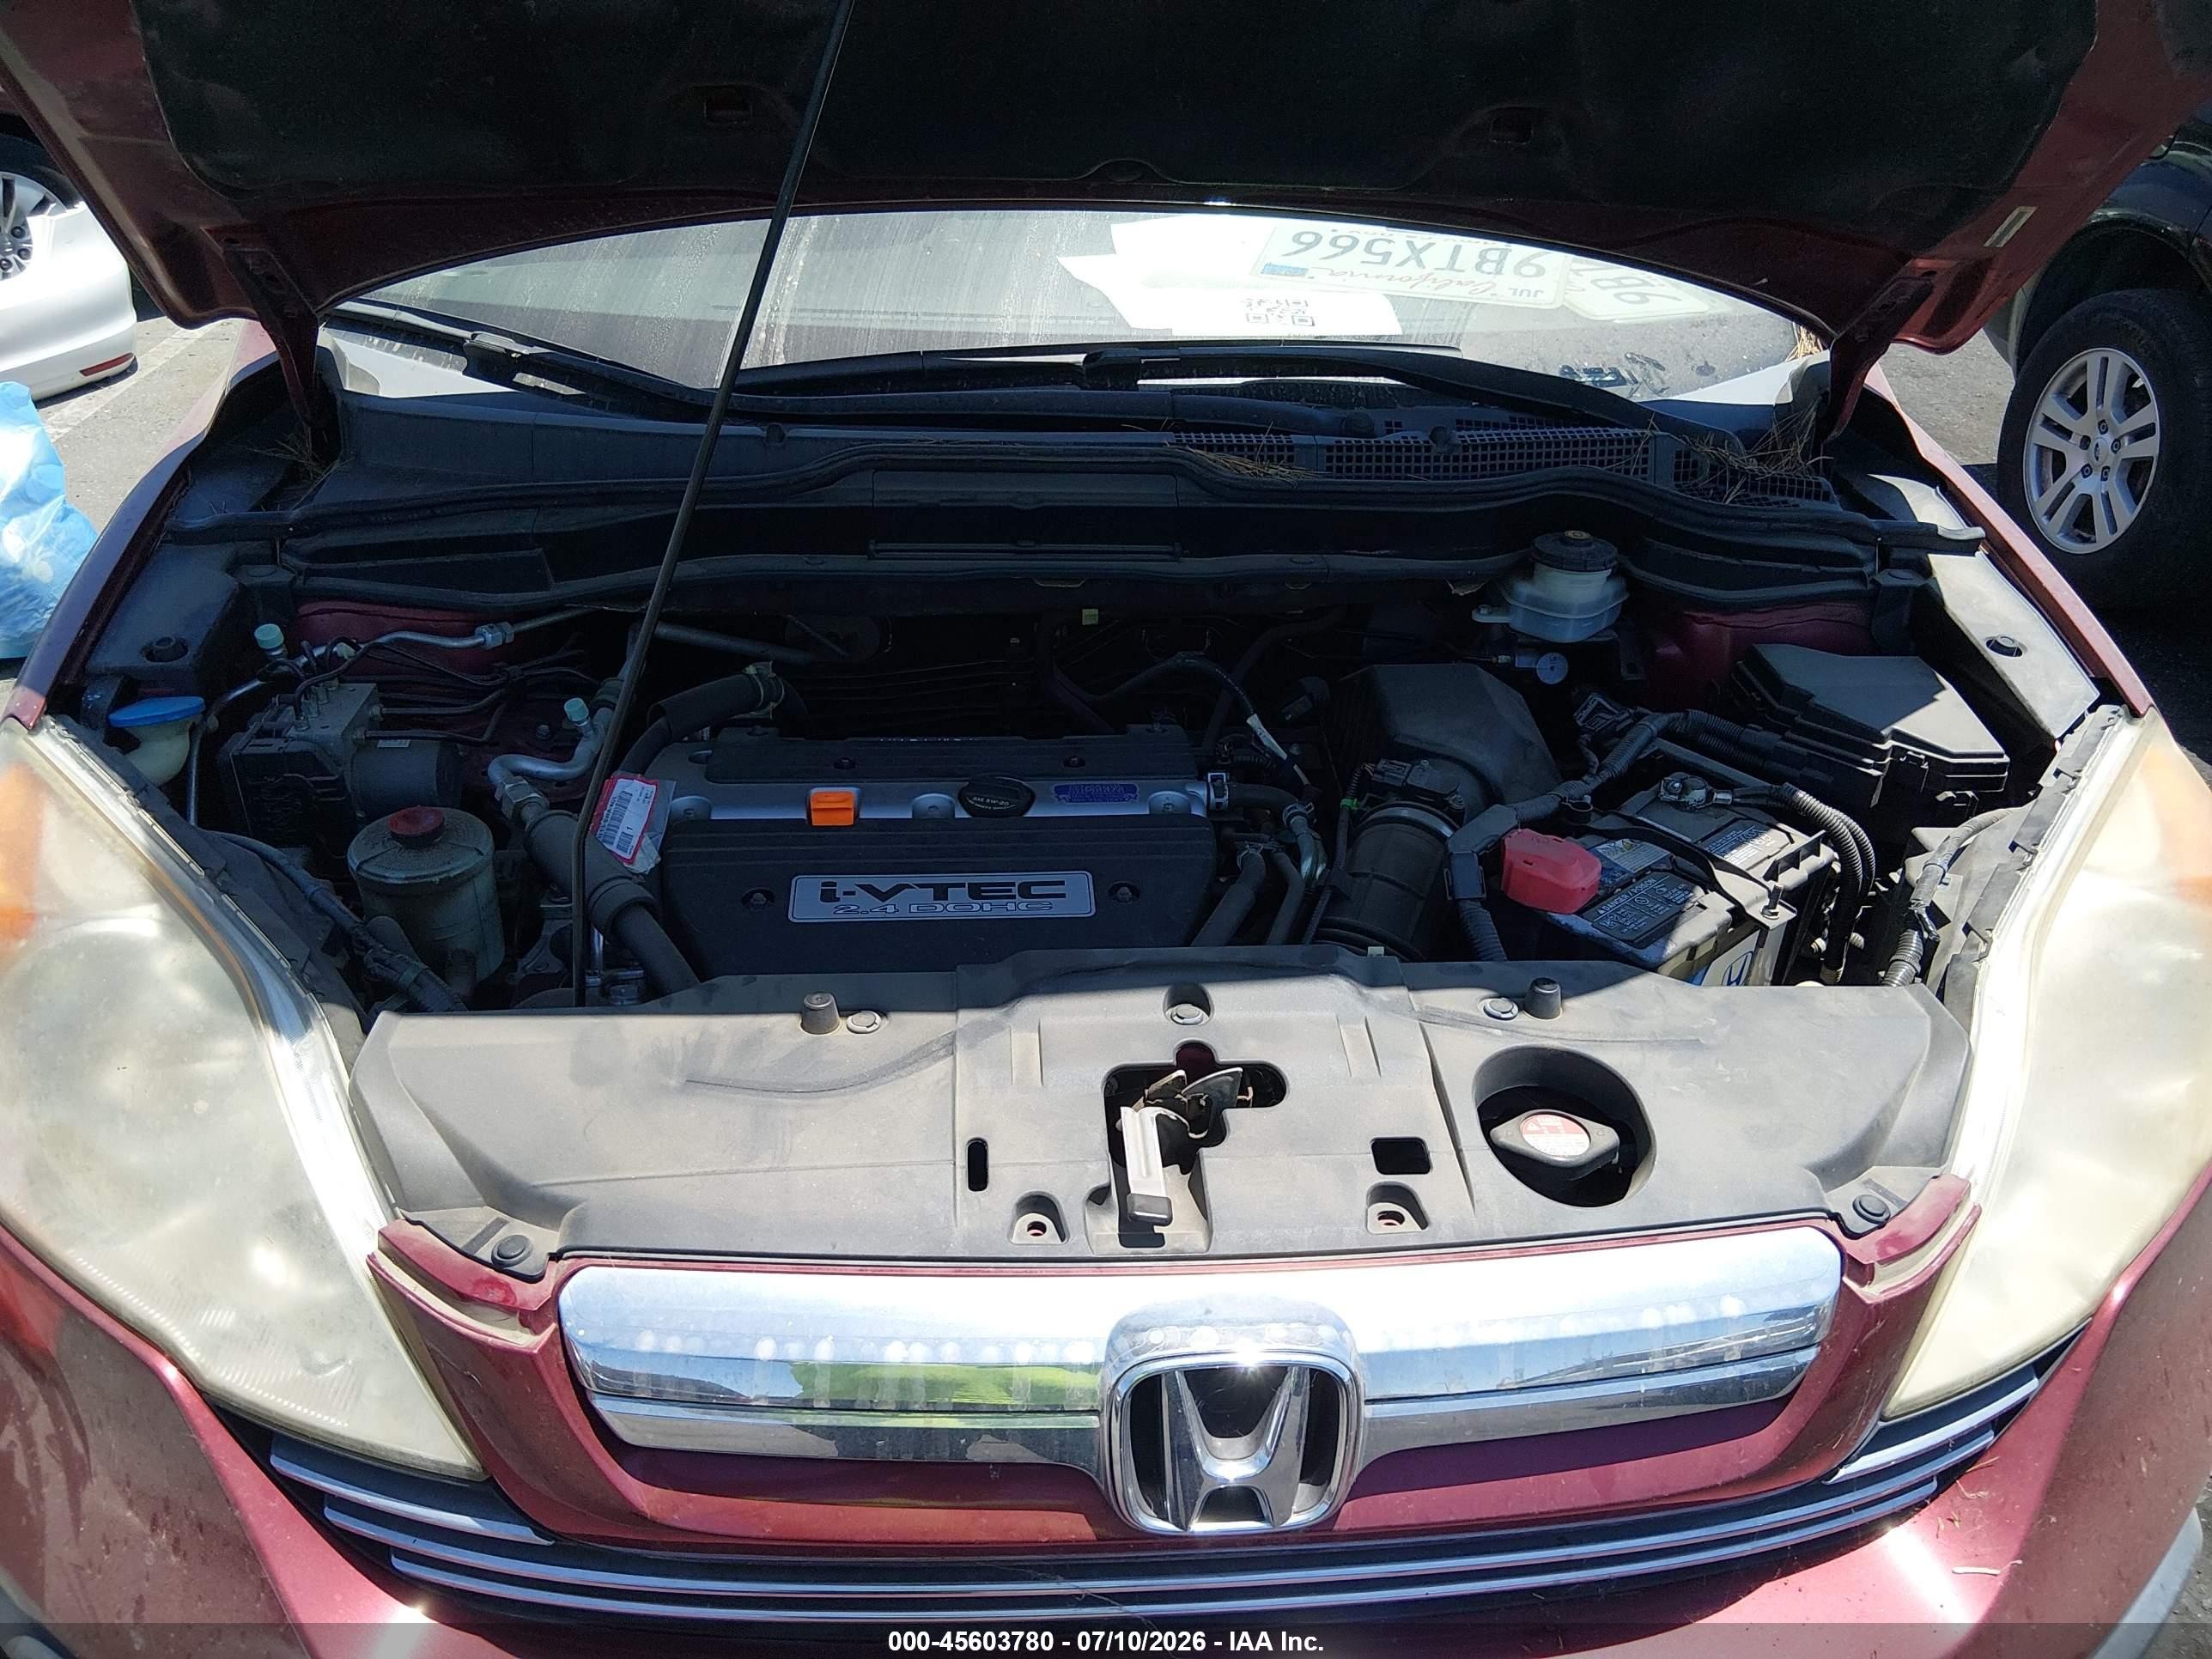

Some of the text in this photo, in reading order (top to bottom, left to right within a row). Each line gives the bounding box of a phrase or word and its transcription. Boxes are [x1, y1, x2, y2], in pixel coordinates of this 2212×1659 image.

[1281, 230, 1553, 277] 9BTX566
[1311, 266, 1500, 295] California
[1508, 287, 1544, 298] JUL
[819, 880, 1066, 902] i-VTEC
[832, 901, 1053, 915] 2.4 DOHC
[1601, 894, 1630, 911] DANGER
